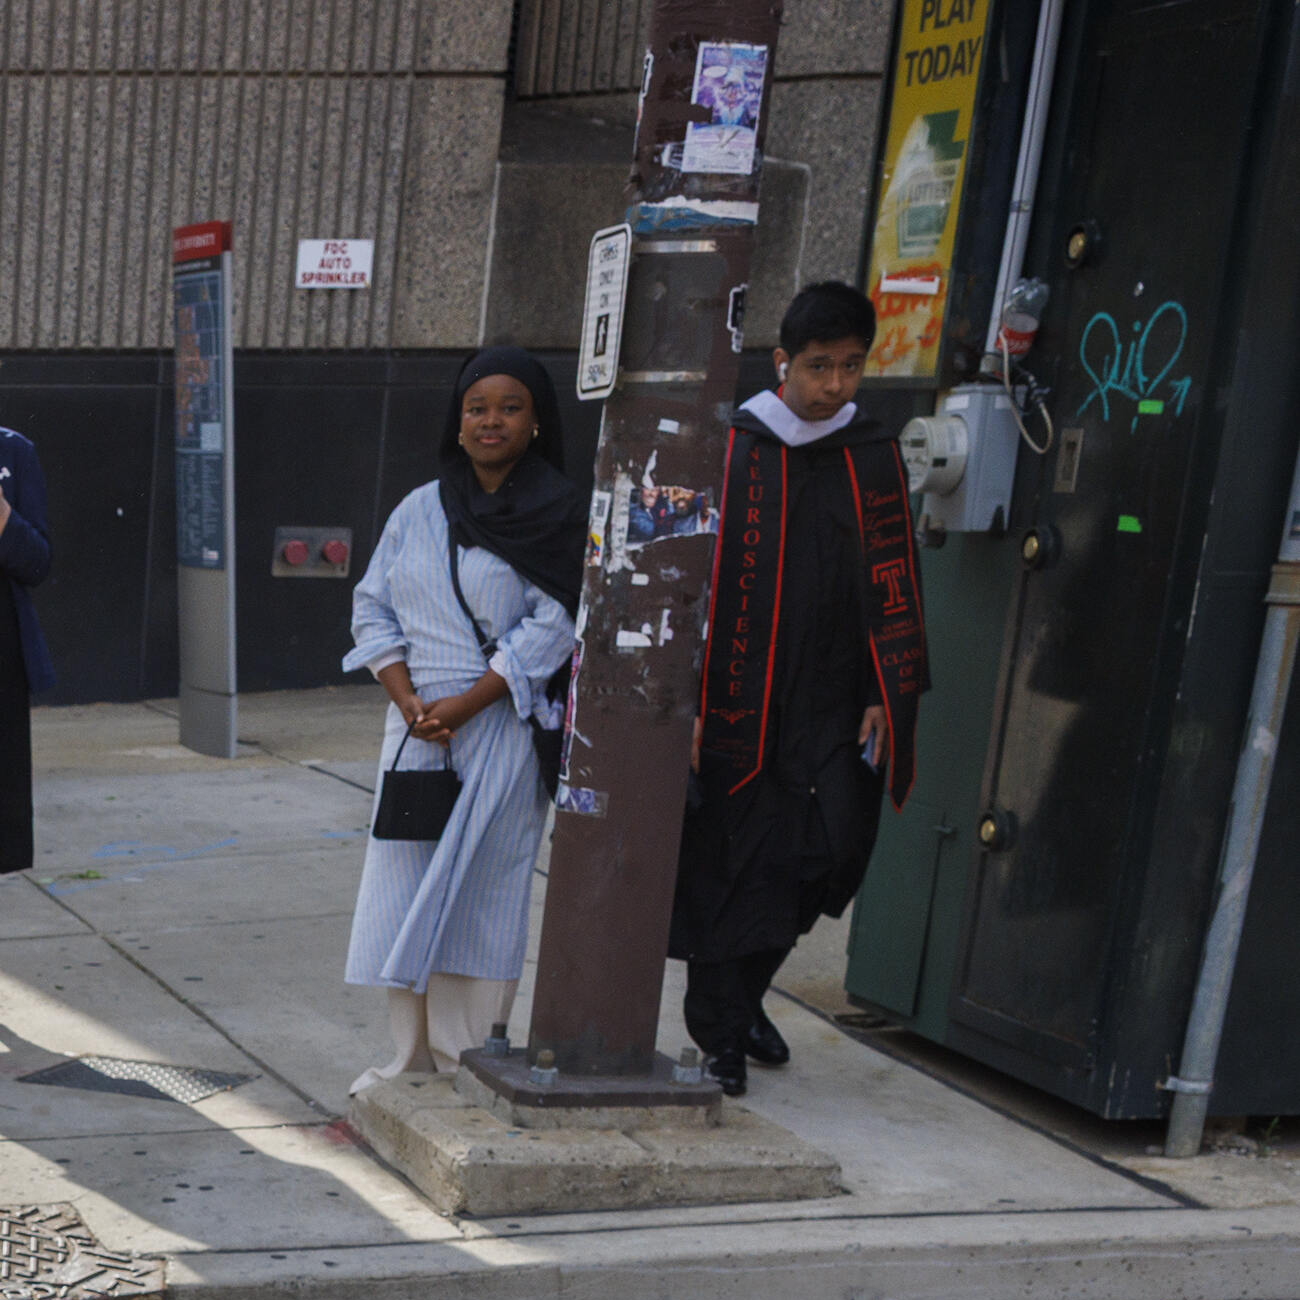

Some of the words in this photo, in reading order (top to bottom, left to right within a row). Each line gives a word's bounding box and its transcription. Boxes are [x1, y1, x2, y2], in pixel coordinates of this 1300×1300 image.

[904, 36, 982, 88] TODAY
[323, 241, 349, 255] FDC
[318, 257, 352, 270] AUTO
[301, 270, 367, 285] SPRINKLER
[729, 446, 764, 698] NEUROSCIENCE
